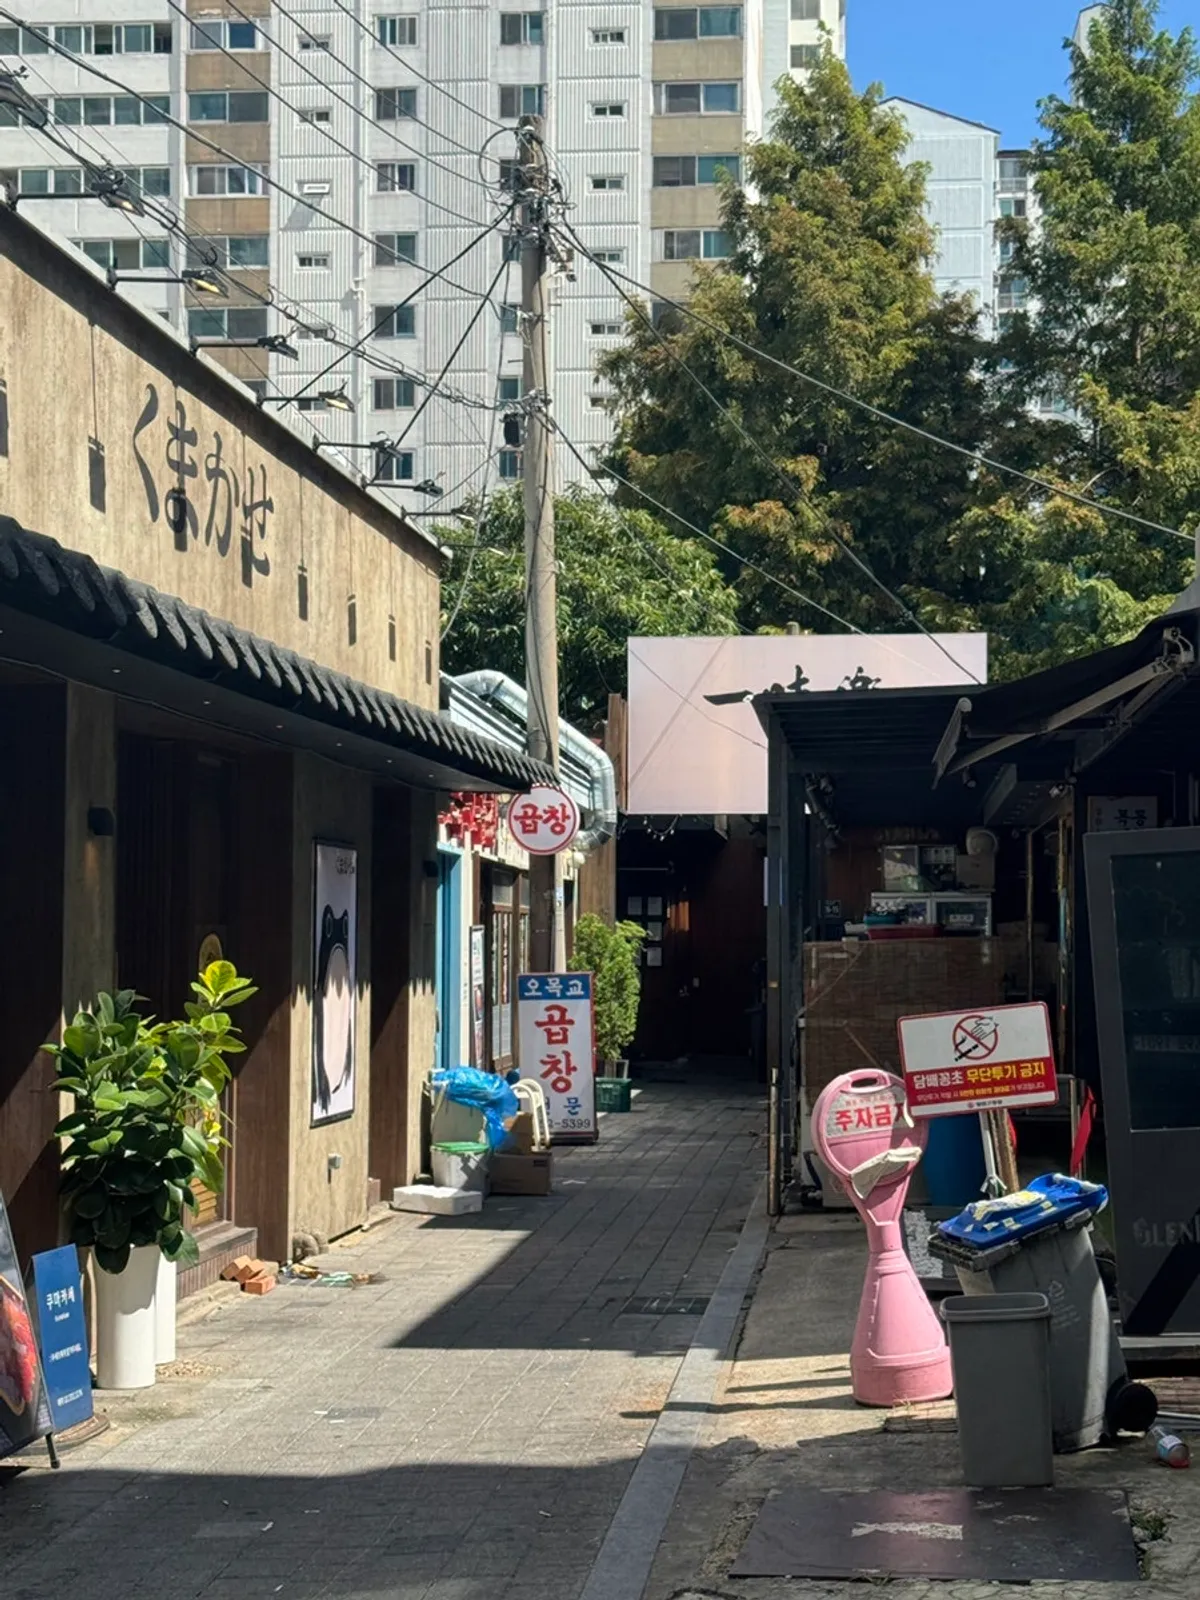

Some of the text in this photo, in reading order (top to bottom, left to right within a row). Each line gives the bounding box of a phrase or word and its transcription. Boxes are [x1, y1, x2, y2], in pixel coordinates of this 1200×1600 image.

[133, 383, 274, 577] くまかせ
[513, 803, 571, 836] 곱창
[524, 978, 585, 997] 오목교
[534, 1004, 578, 1093] 곱창
[913, 1061, 1046, 1090] 담배꽁초 무단투기 금지
